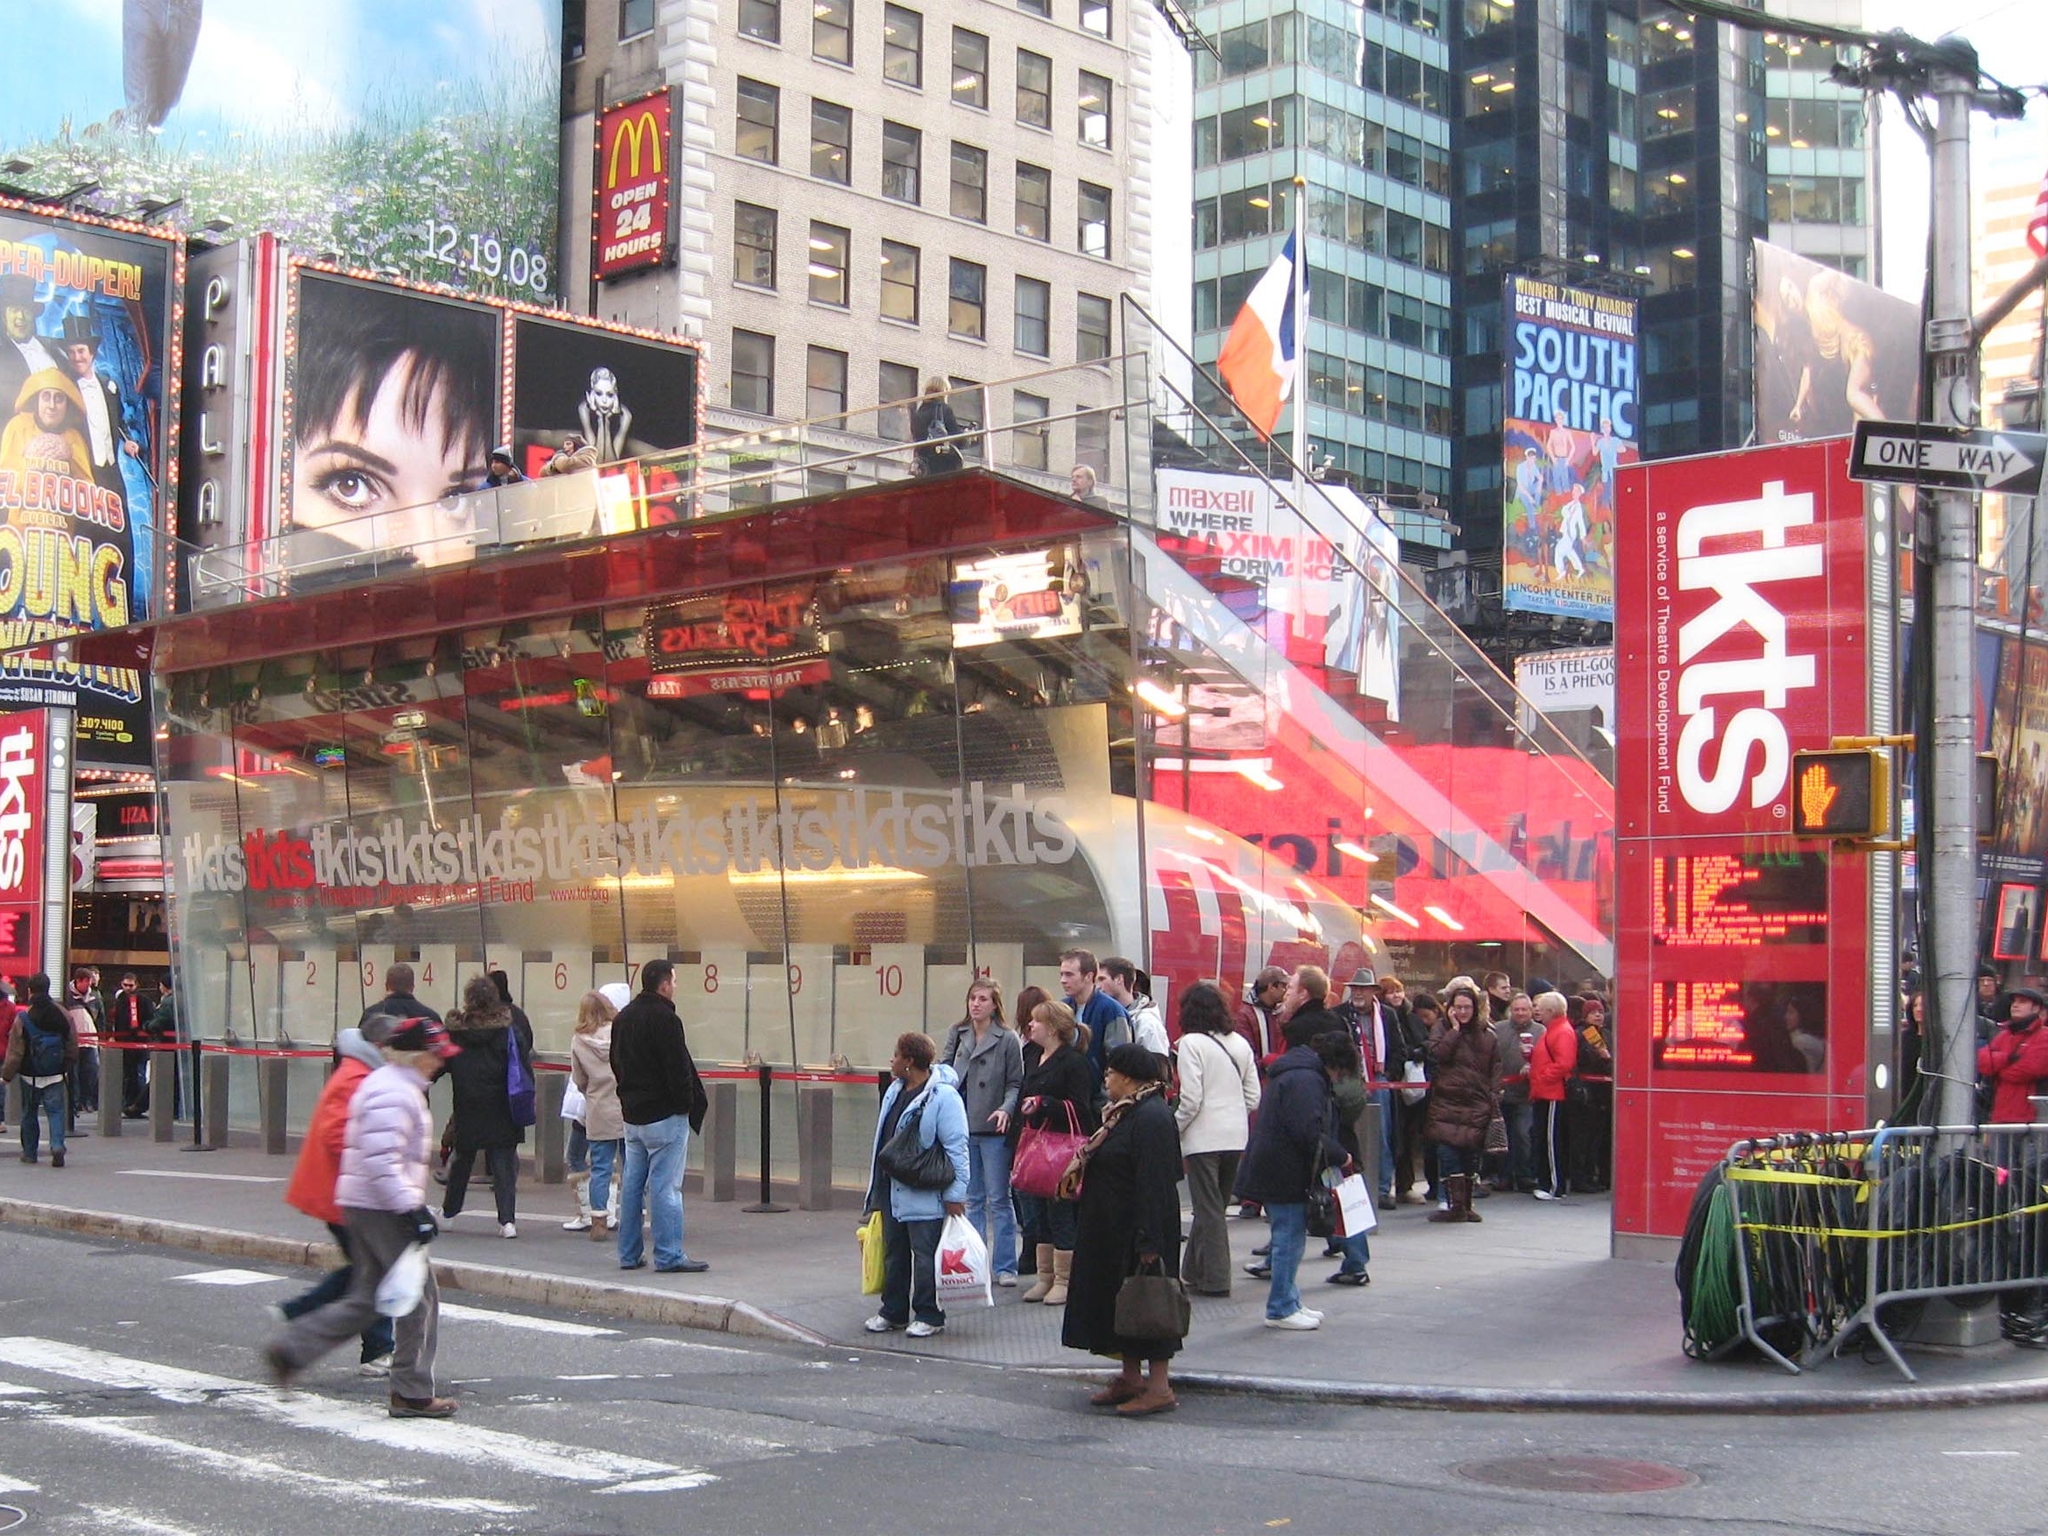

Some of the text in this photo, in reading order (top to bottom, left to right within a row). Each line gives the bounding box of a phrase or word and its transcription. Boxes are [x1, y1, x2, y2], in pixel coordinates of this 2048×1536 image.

[611, 181, 657, 210] OPEN
[615, 202, 651, 239] 24
[423, 219, 547, 292] 12.19.08
[604, 231, 662, 263] HOURS
[1515, 278, 1633, 318] WINNER! 7 TONY AWARDS
[1515, 293, 1634, 337] BEST MUSICAL REVIVAL
[1515, 322, 1634, 390] SOUTH
[1514, 368, 1633, 439] PACIFIC
[1879, 441, 2015, 474] ONE WAY
[23, 470, 124, 532] BROOKS
[1169, 487, 1254, 513] maxell
[20, 510, 68, 528] MUSICAL
[1169, 510, 1253, 533] WHERE
[1511, 583, 1552, 597] LINCOLN
[1554, 588, 1593, 602] CENTER
[1677, 480, 1823, 814] tkts
[1654, 511, 1671, 814] a service of Theatre Development Fund
[20, 687, 43, 703] SUSAN
[44, 688, 77, 706] STROMAN
[1545, 673, 1614, 691] IS A PHENO
[488, 876, 535, 904] Fund
[305, 962, 317, 986] 2
[363, 961, 375, 987] 3
[422, 962, 434, 987] 4
[554, 962, 568, 991] 6
[628, 962, 640, 990] 7
[703, 963, 719, 993] 8
[788, 964, 803, 995] 9
[875, 964, 903, 997] 10
